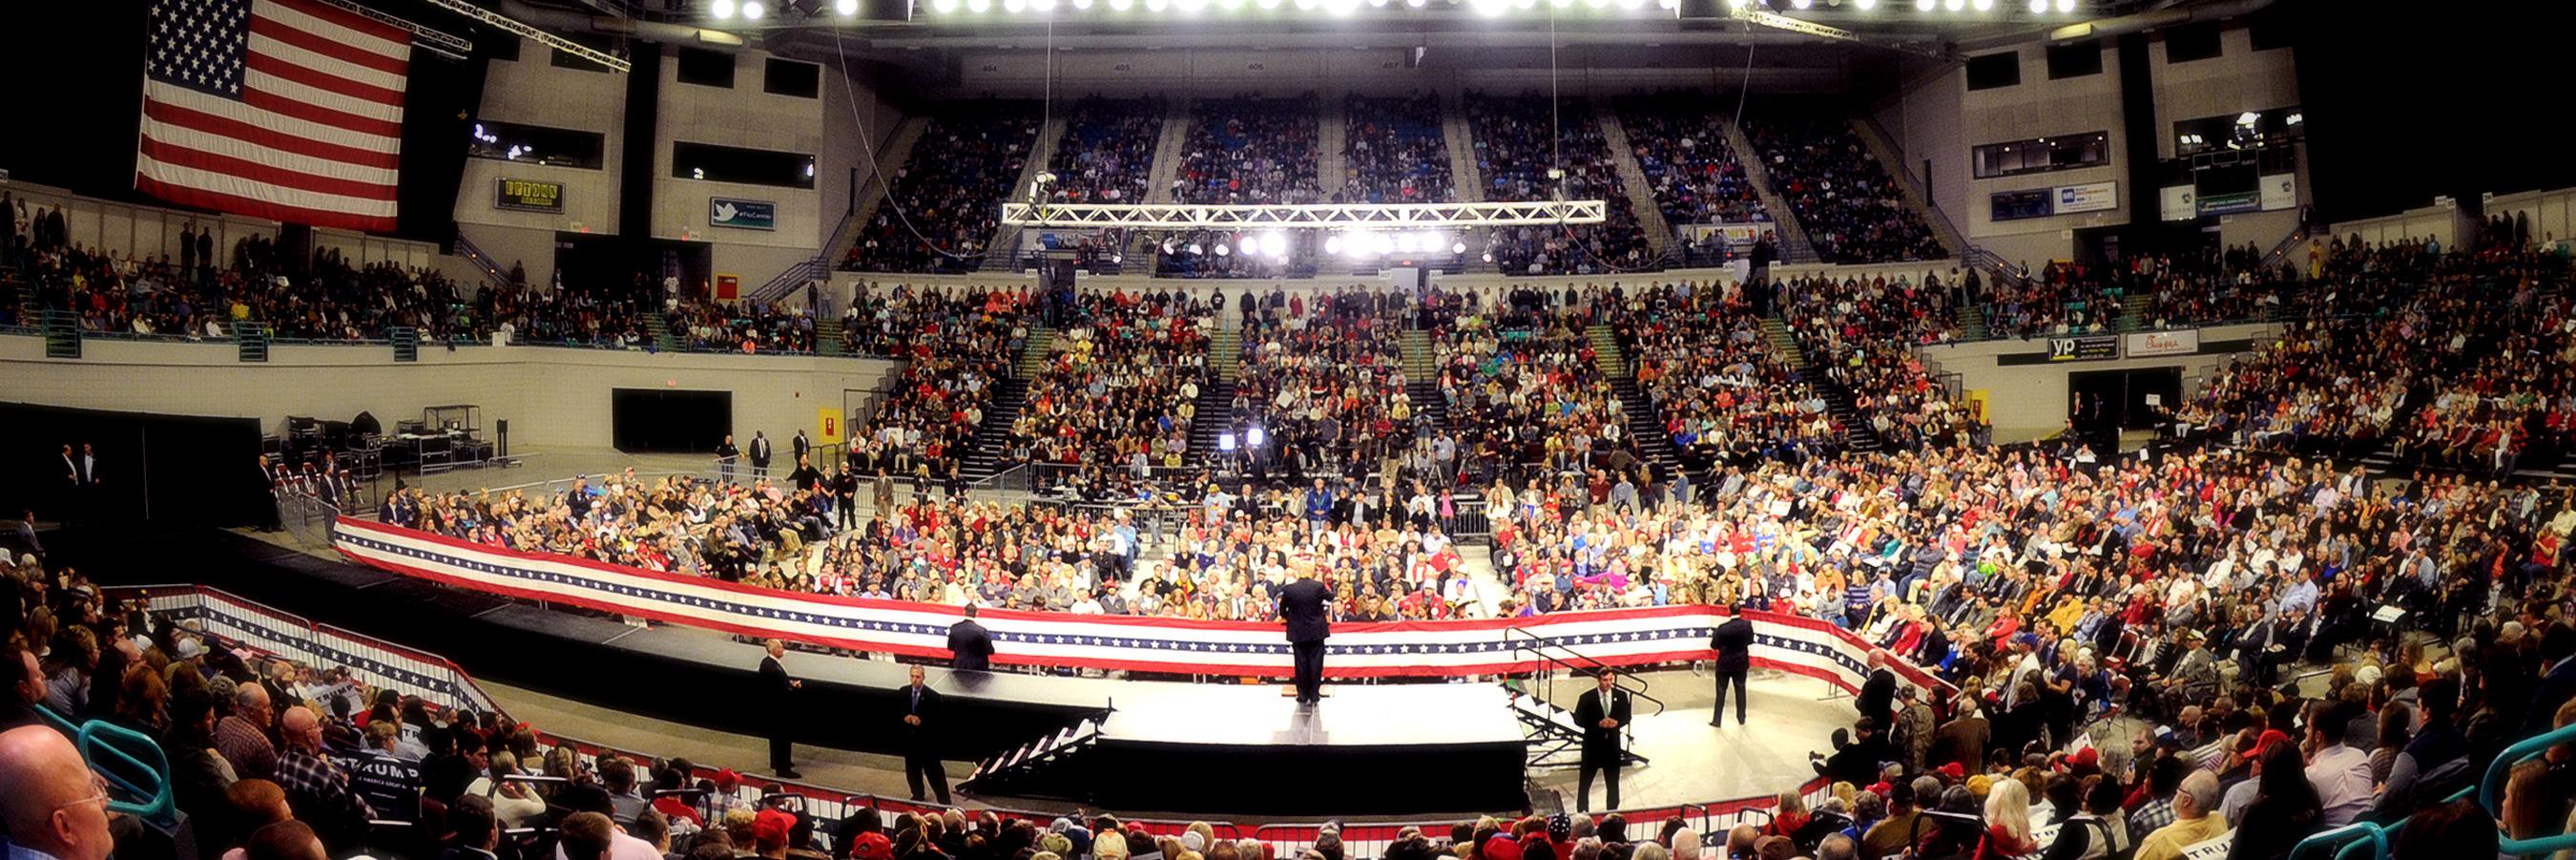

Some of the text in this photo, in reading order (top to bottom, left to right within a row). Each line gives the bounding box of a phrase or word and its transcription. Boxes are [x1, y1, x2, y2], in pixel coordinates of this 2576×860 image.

[506, 181, 557, 199] UPTOWN
[2052, 339, 2075, 356] yp
[316, 683, 354, 703] TRUMP
[404, 728, 420, 738] TR
[347, 757, 420, 779] TRUMP
[2187, 843, 2230, 859] TRU
